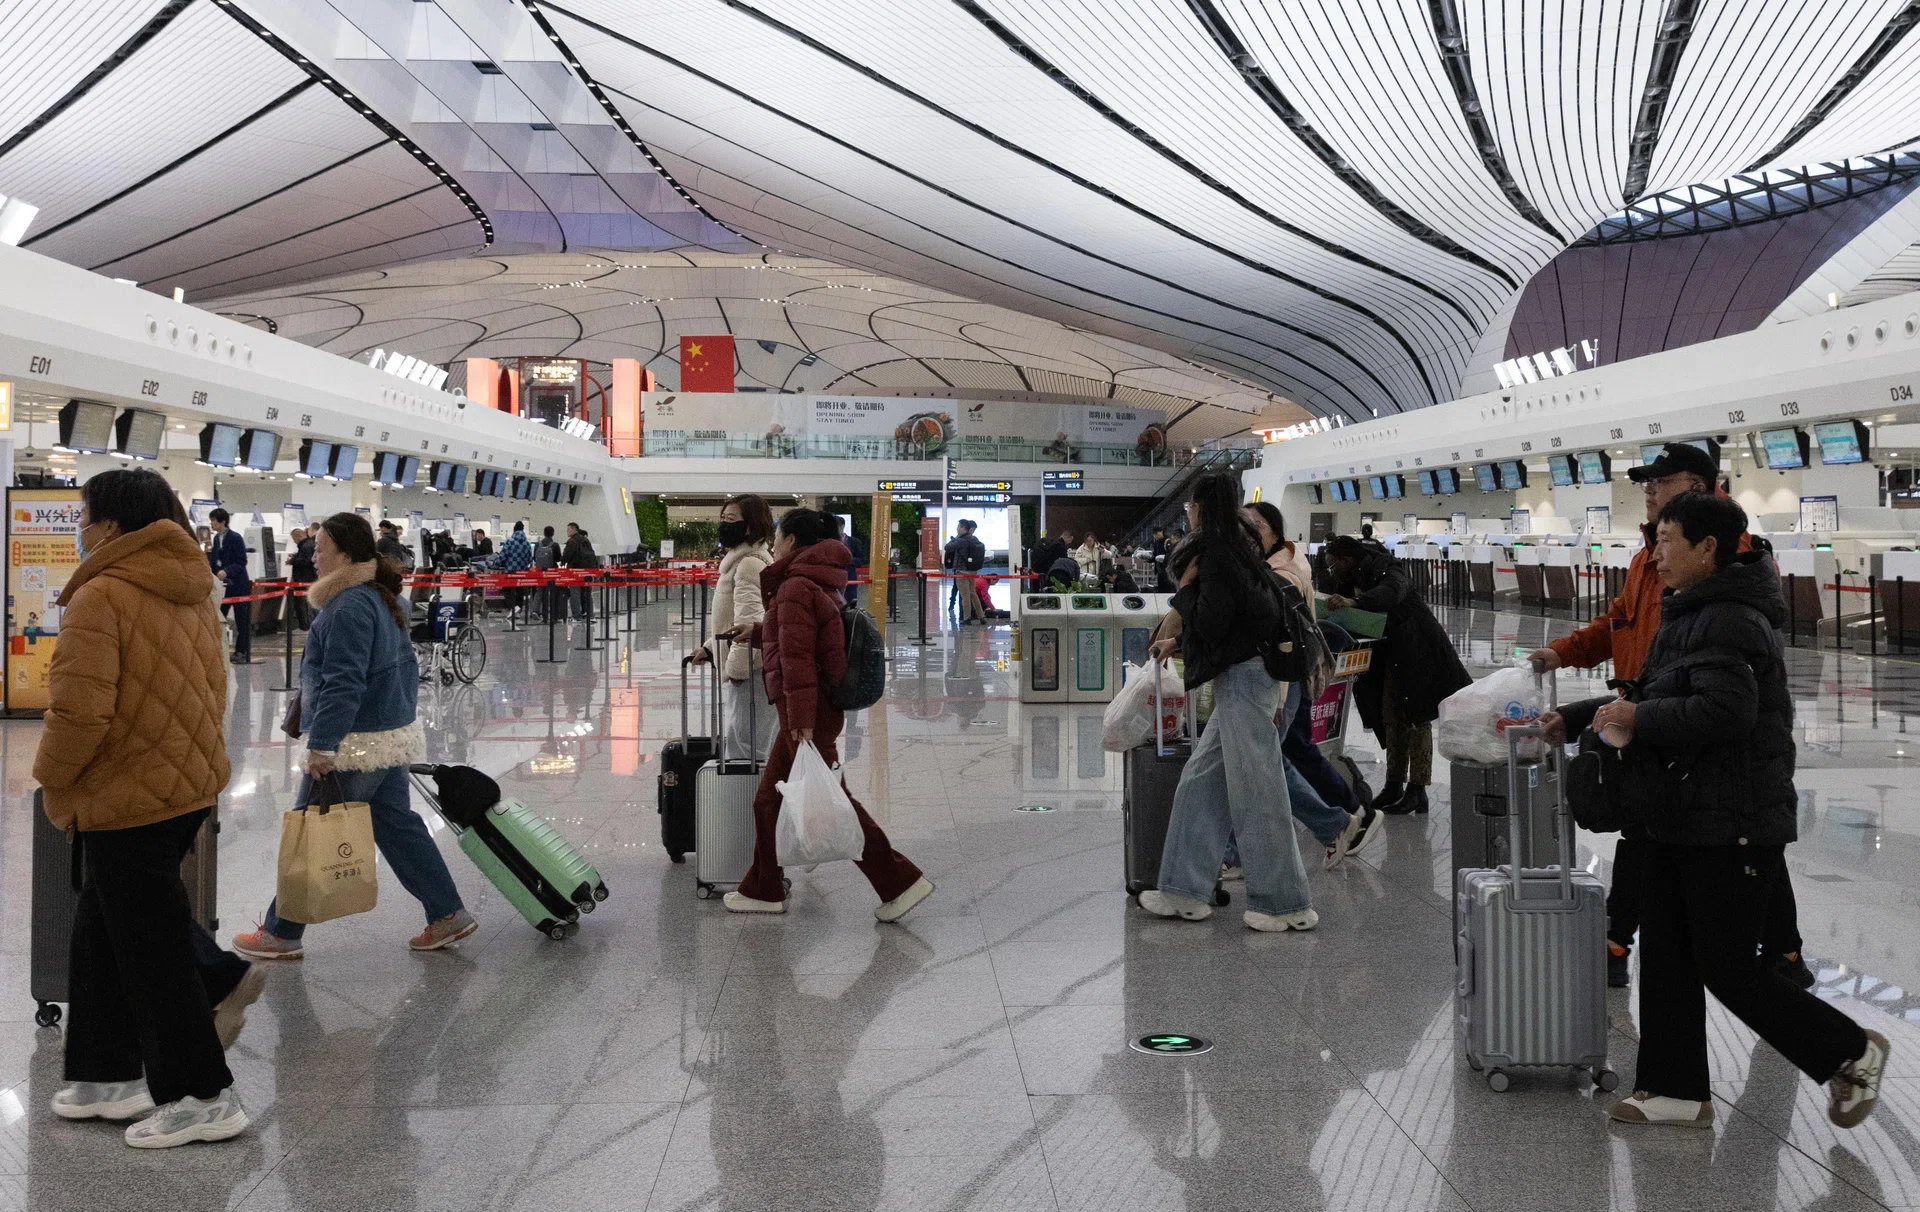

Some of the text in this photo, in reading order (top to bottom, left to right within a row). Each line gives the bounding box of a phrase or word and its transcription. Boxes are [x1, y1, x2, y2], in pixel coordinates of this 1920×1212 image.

[29, 355, 51, 376] E01
[141, 379, 159, 397] E02
[1890, 385, 1913, 402] D34
[191, 390, 208, 406] E03
[266, 406, 279, 421] E04
[1780, 401, 1800, 416] D33
[300, 413, 313, 427] E05
[1728, 410, 1746, 424] D32
[354, 425, 365, 438] E06
[1610, 427, 1623, 440] D30
[1648, 422, 1662, 435] D31
[380, 431, 390, 442] E07
[1550, 436, 1562, 449] D29
[1475, 448, 1484, 458] D27
[1521, 441, 1532, 452] D28
[1451, 452, 1460, 461] D26
[620, 487, 631, 514] E
